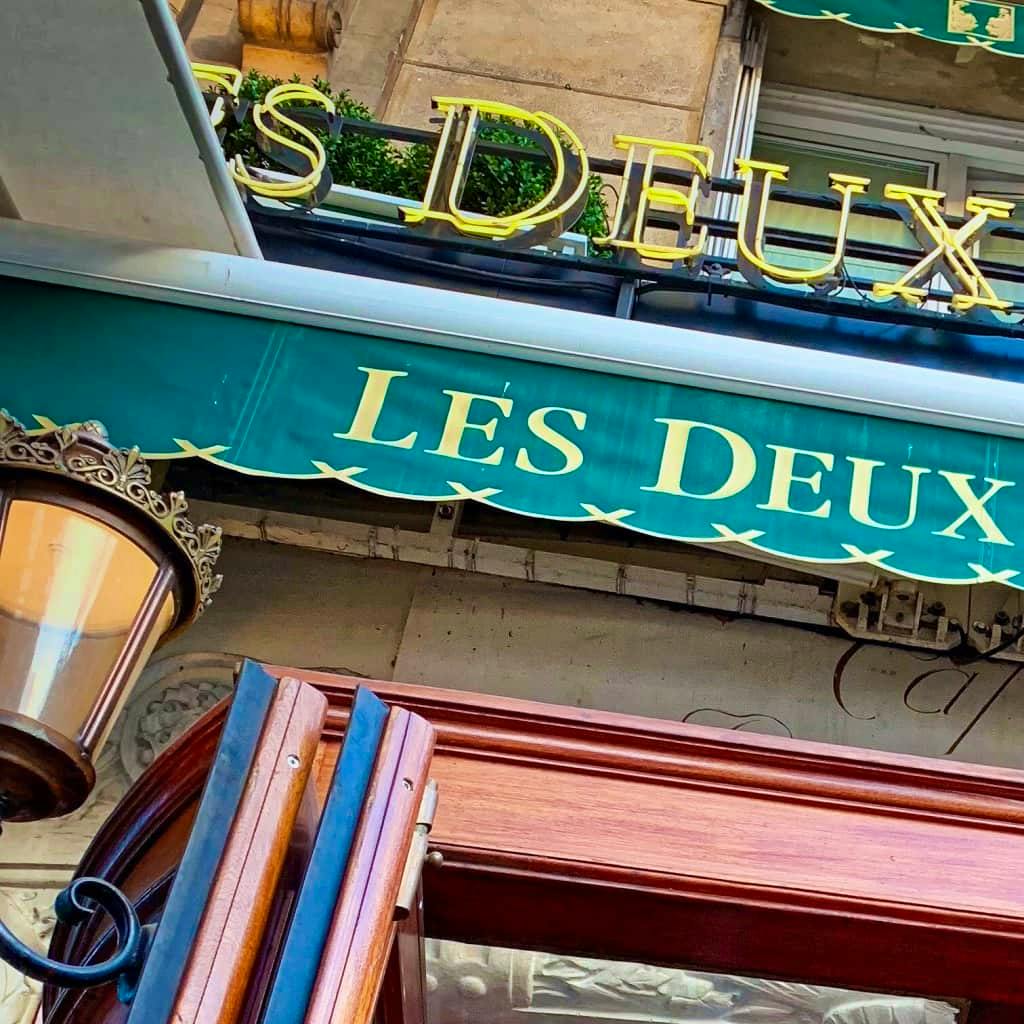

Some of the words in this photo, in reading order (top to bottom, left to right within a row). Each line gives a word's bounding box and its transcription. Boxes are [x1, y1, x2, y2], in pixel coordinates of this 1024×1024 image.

[399, 95, 1015, 310] DEUX
[333, 366, 586, 476] LES
[641, 417, 1015, 546] DEUX
